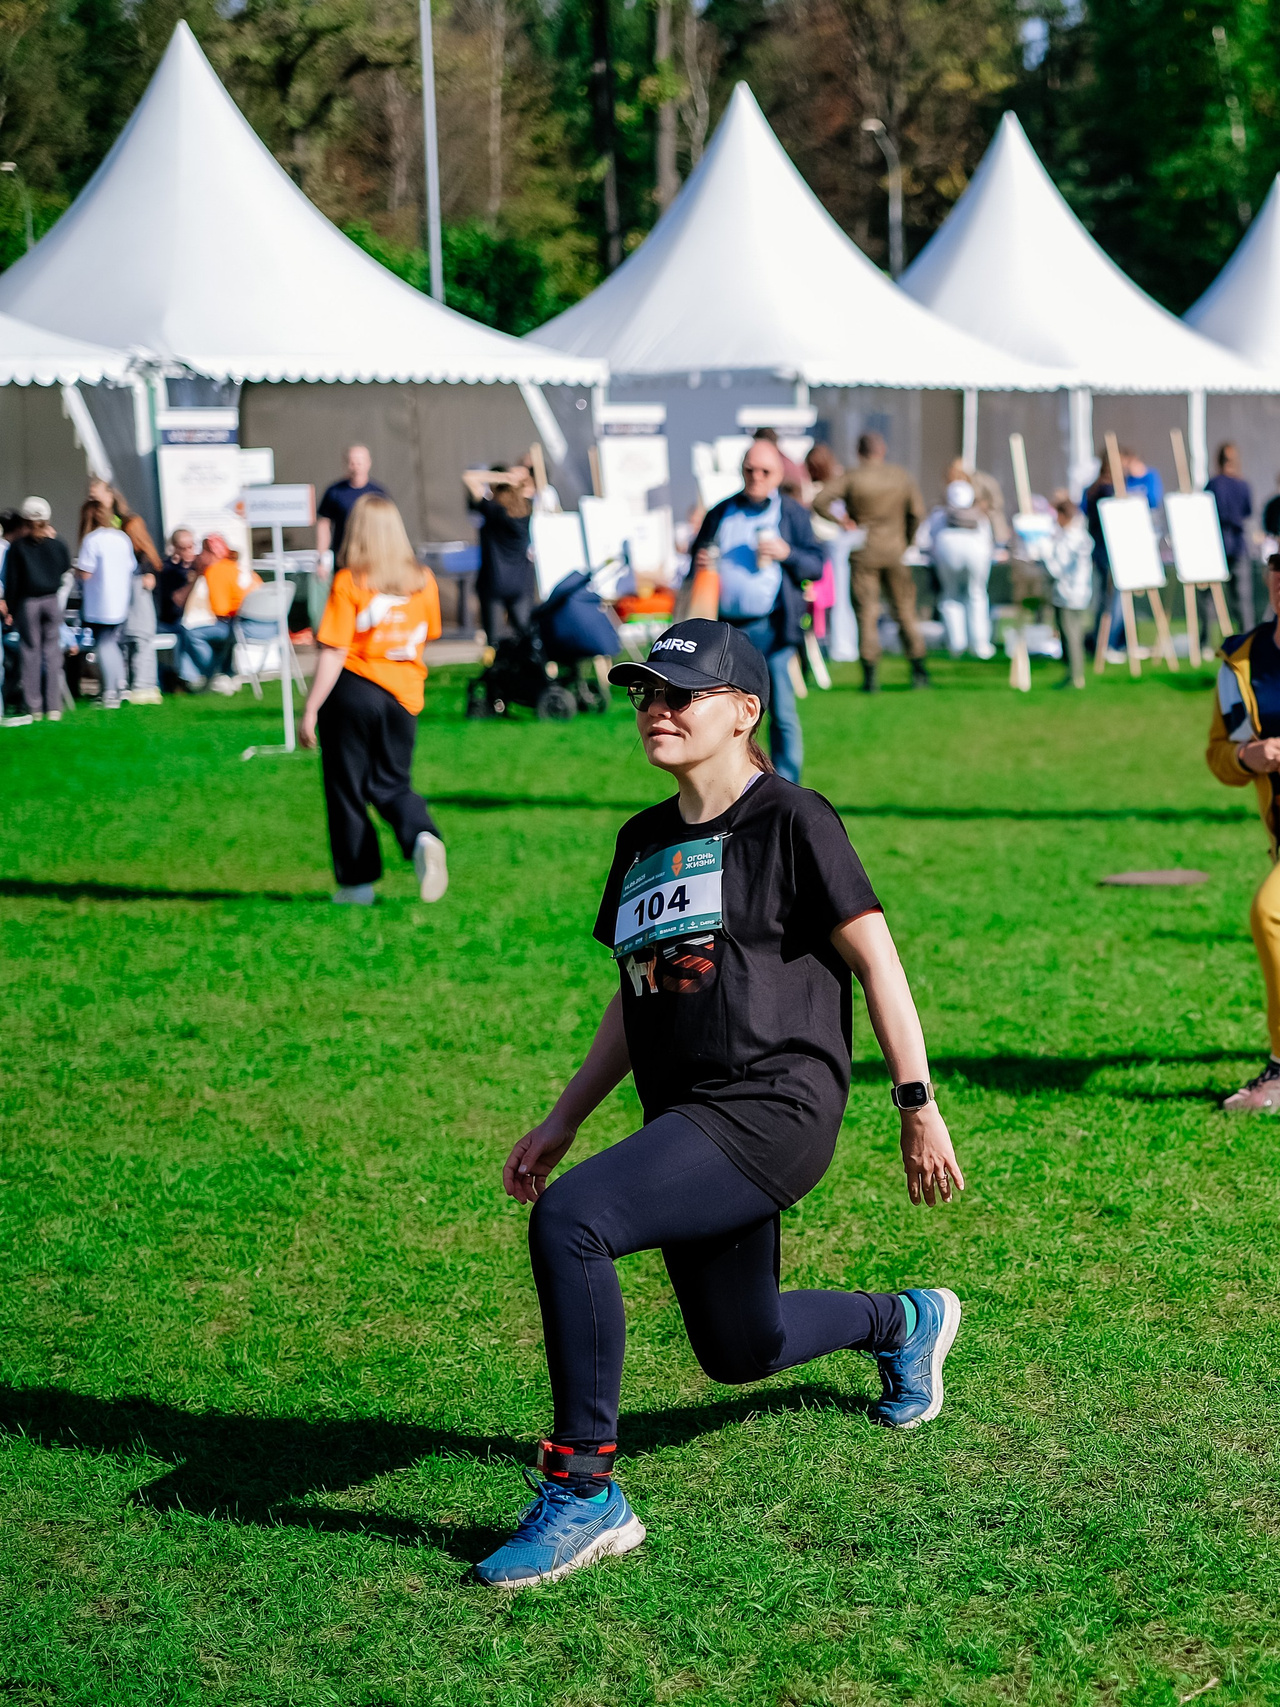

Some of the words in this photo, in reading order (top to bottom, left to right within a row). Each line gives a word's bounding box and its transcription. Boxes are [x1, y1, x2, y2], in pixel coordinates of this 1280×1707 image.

[651, 638, 698, 654] DARS
[685, 858, 716, 870] ЖИЗНИ
[687, 852, 714, 863] ОГОНЬ
[633, 885, 691, 927] 104
